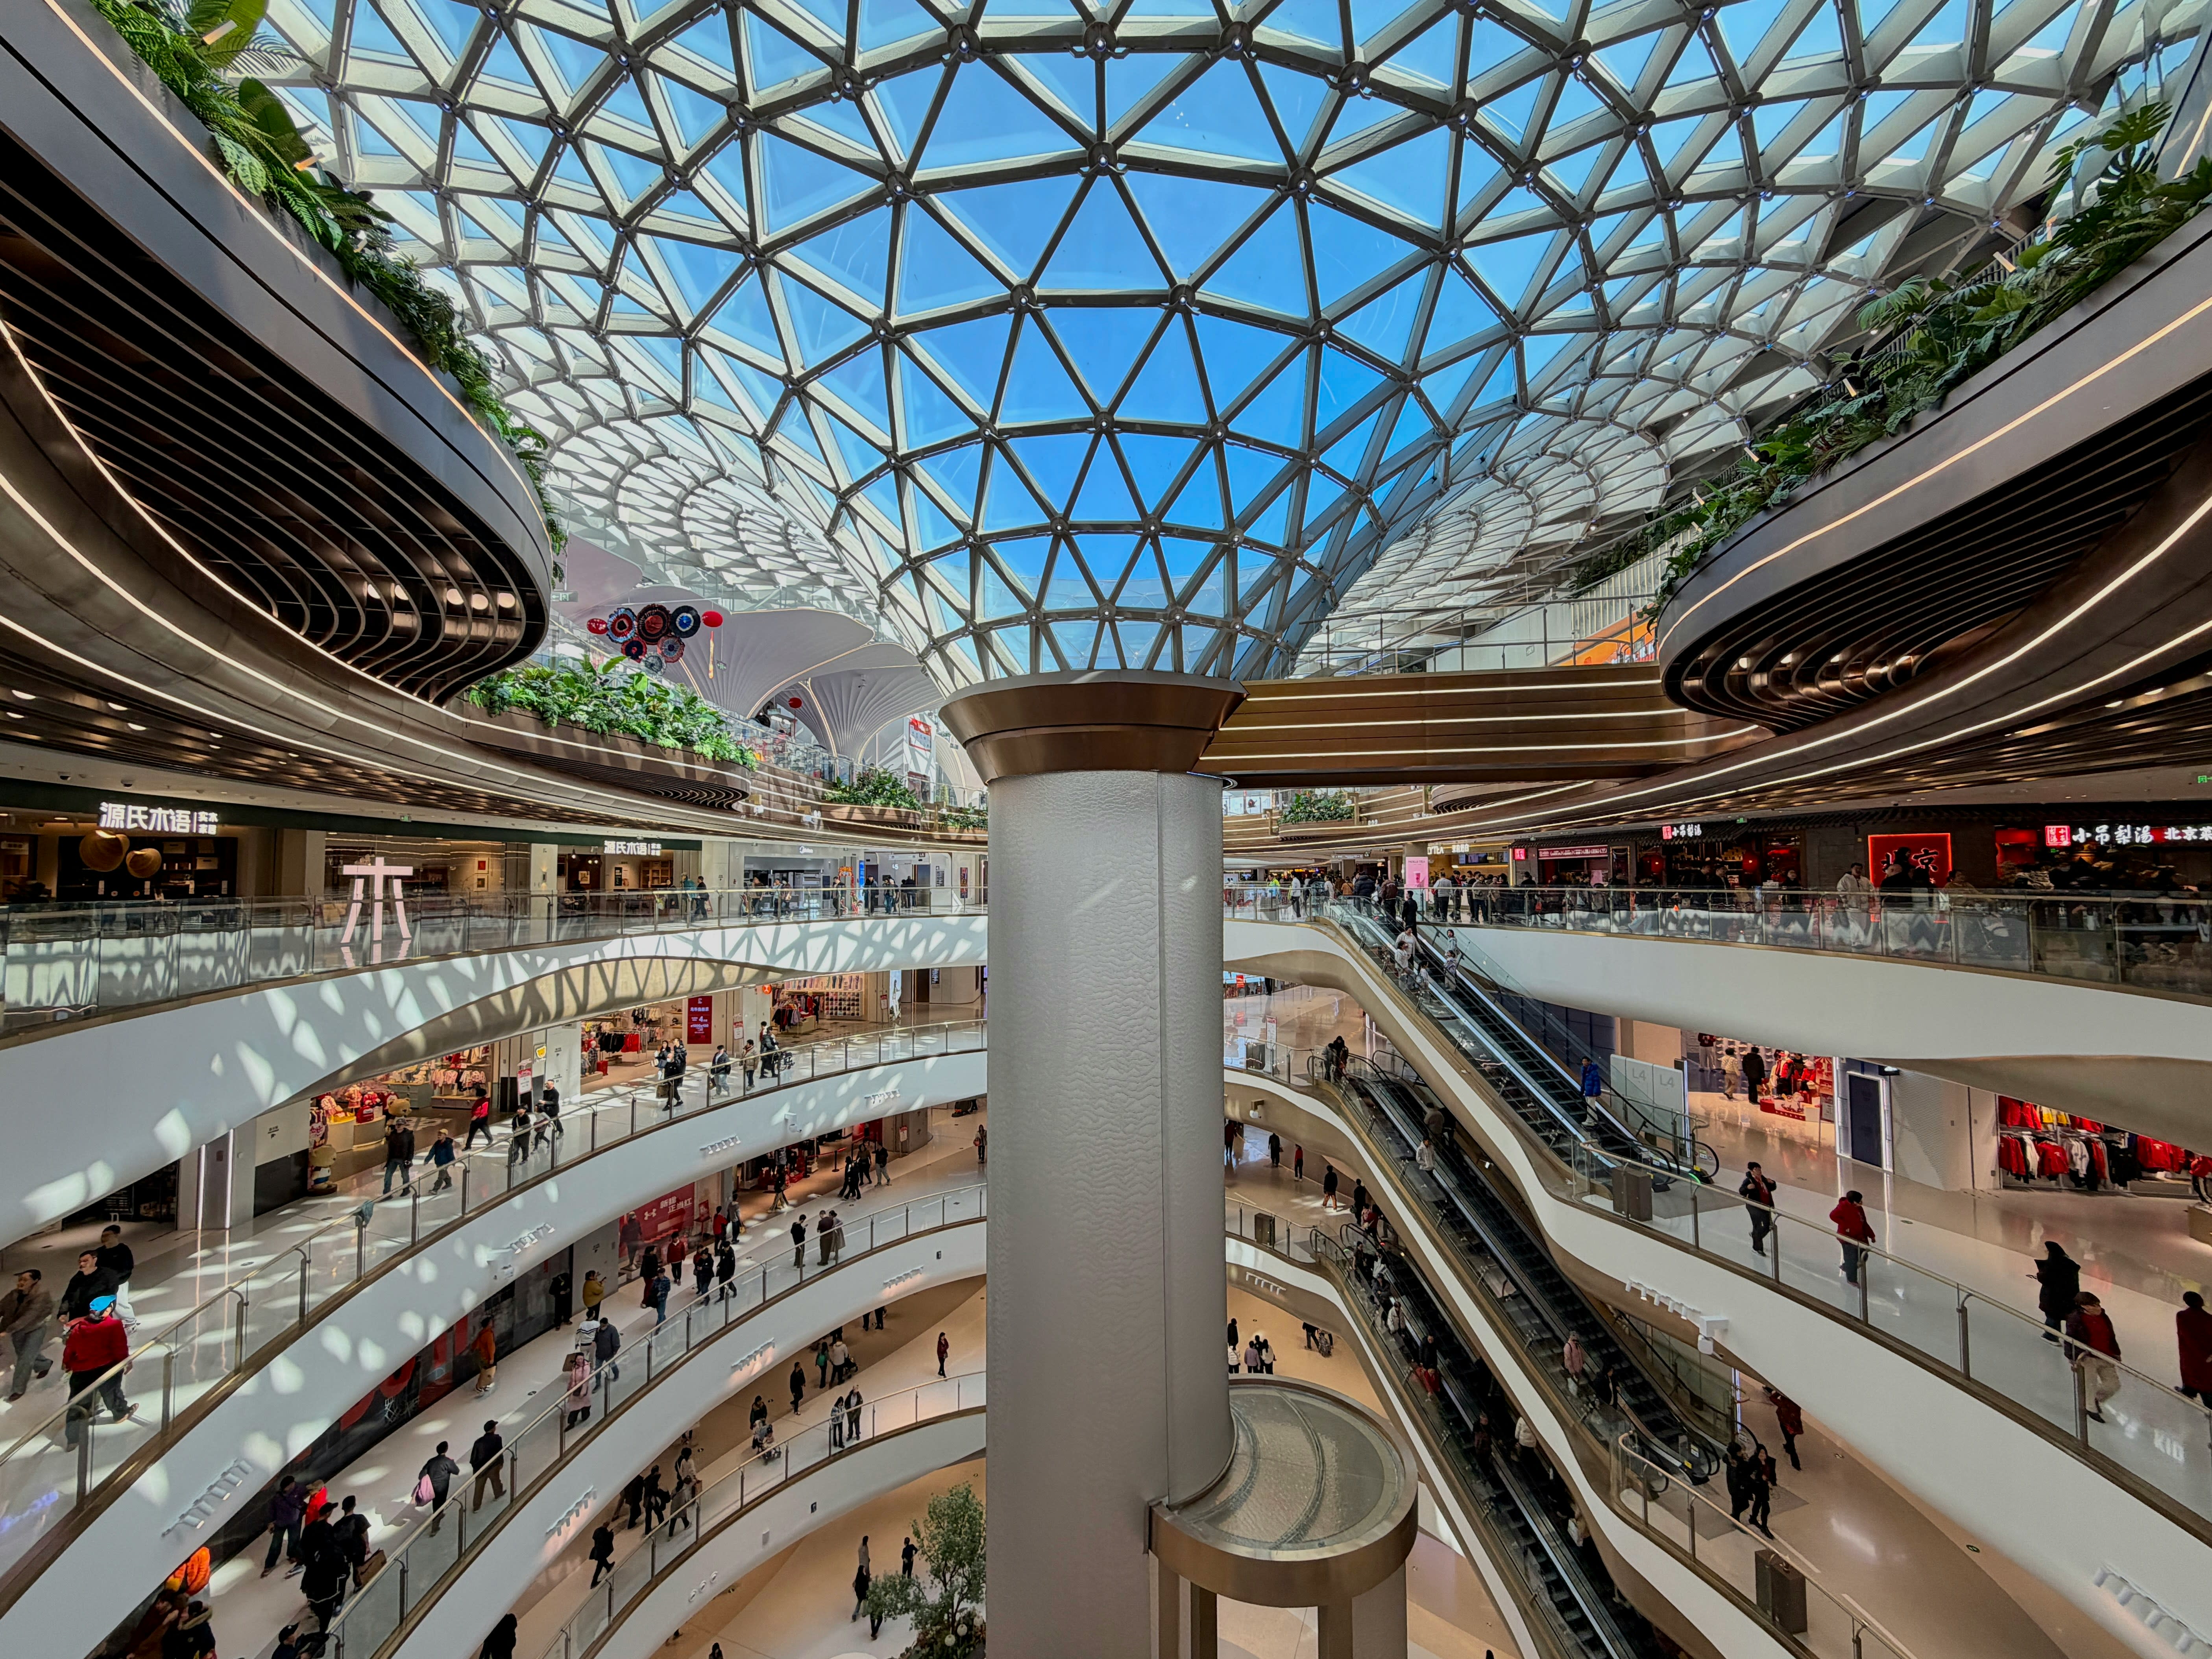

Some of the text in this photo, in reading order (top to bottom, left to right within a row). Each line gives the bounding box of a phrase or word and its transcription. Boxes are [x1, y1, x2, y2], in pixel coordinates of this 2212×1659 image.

[99, 802, 191, 833] 源氏木语
[604, 840, 647, 855] 源氏木语
[1659, 1074, 1674, 1088] L4
[668, 1197, 692, 1214] 正当红
